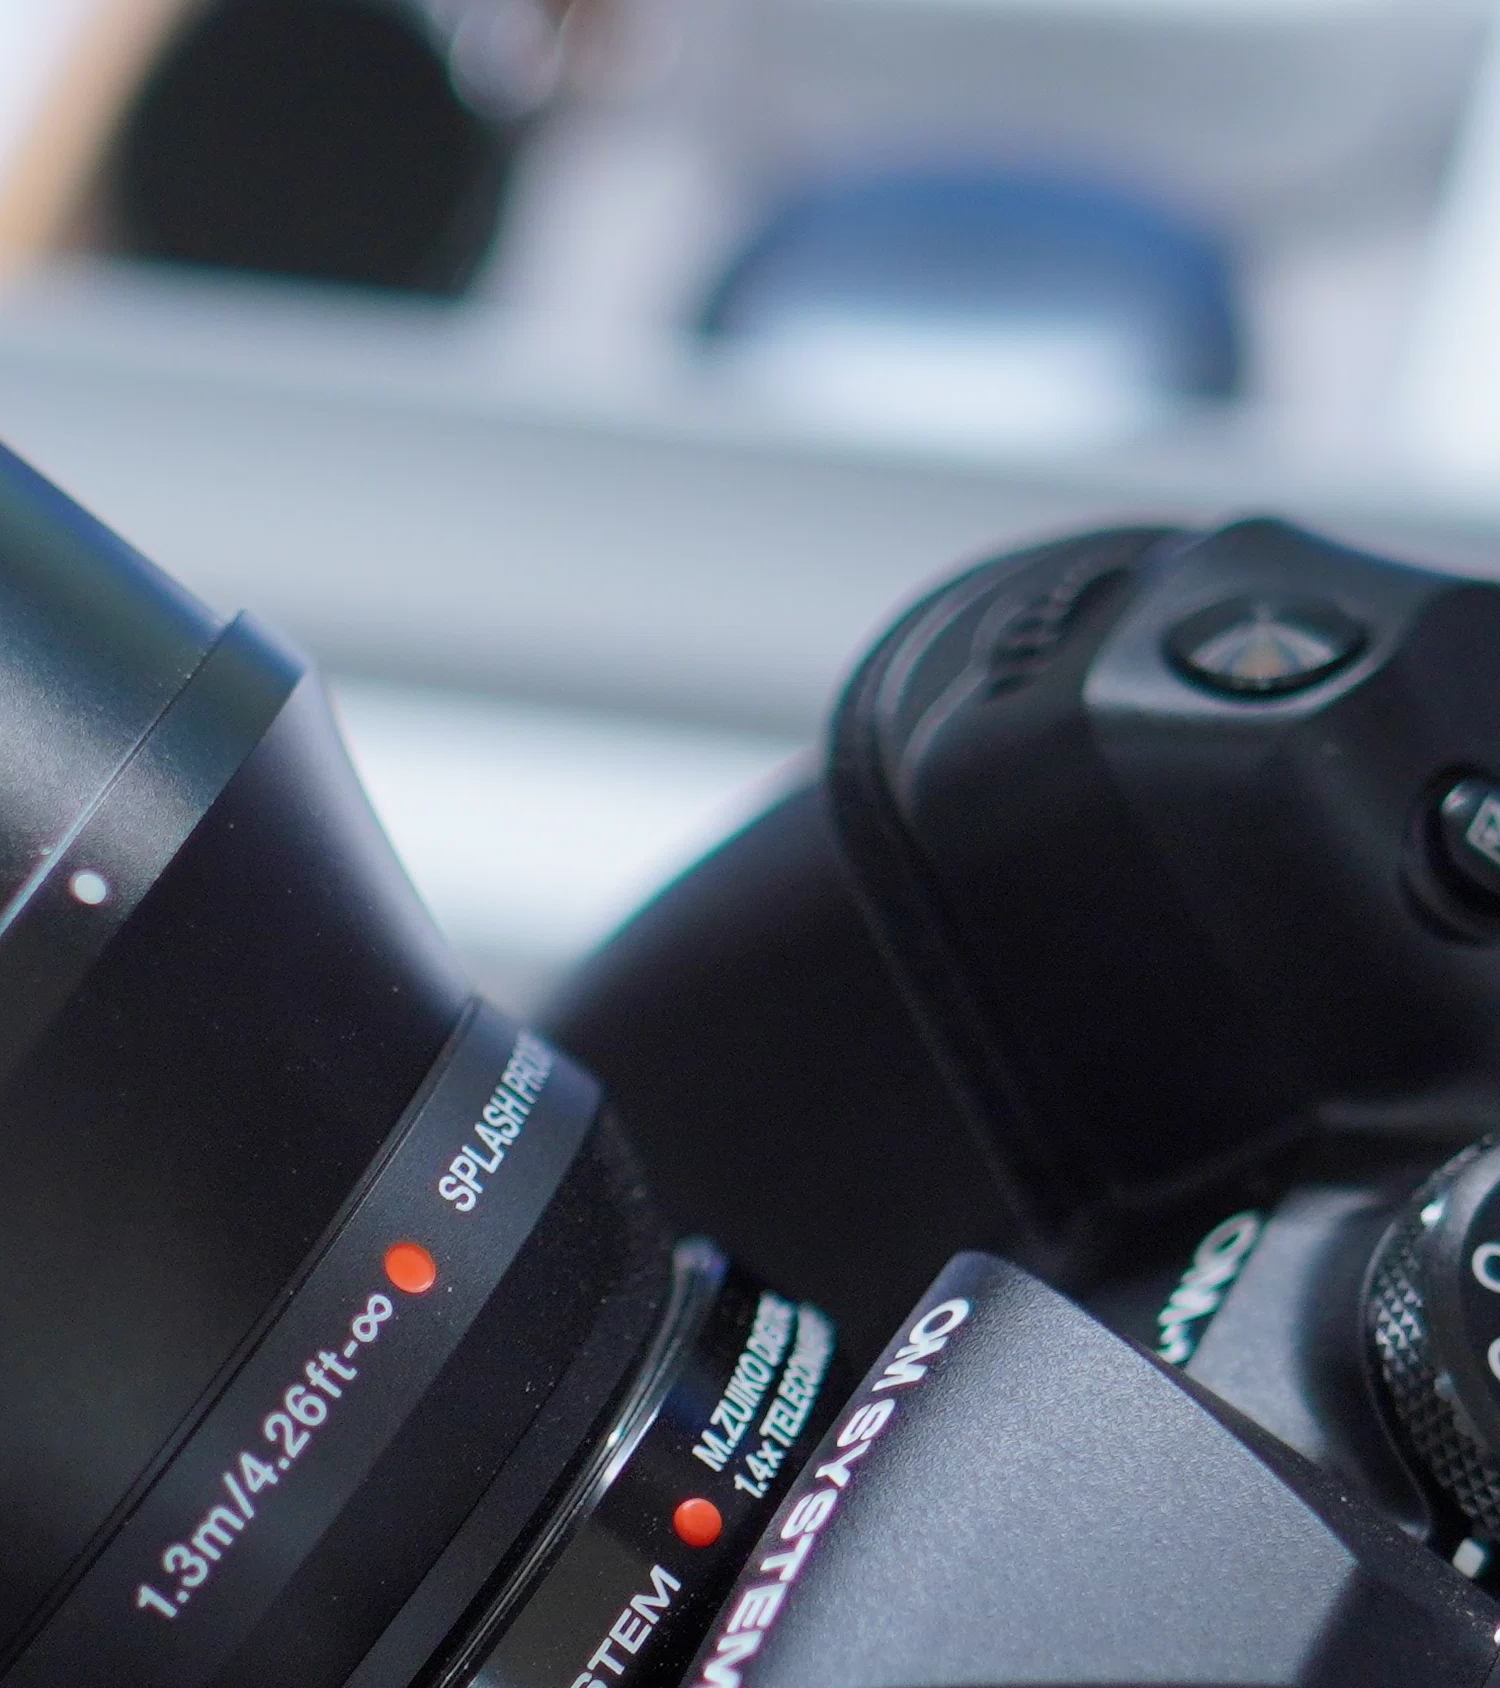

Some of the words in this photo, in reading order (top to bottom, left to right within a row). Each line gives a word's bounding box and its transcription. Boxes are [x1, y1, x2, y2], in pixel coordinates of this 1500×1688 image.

[438, 1085, 530, 1212] SPLASH
[873, 1298, 970, 1391] OM
[692, 1353, 774, 1472] M.ZUIKO
[734, 1440, 785, 1499] 1.4x
